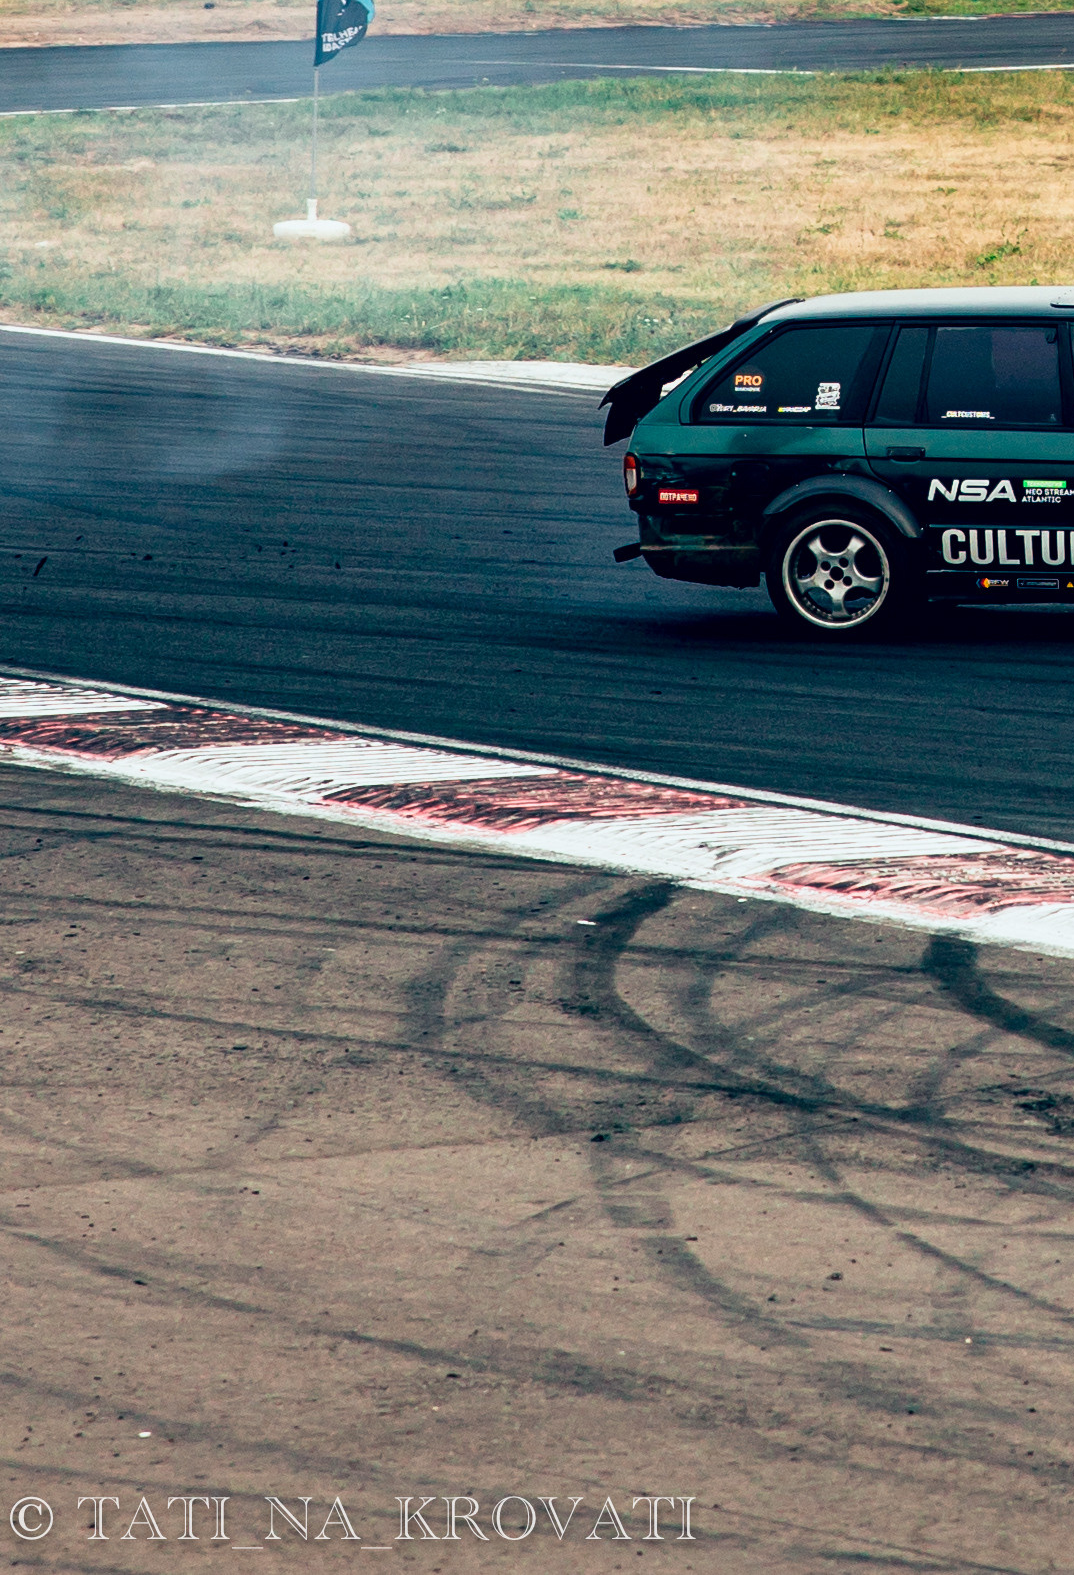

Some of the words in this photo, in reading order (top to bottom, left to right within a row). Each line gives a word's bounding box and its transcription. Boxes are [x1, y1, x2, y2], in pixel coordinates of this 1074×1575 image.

[735, 375, 763, 387] PRO
[928, 479, 1017, 503] NSA
[1026, 488, 1043, 496] NEO
